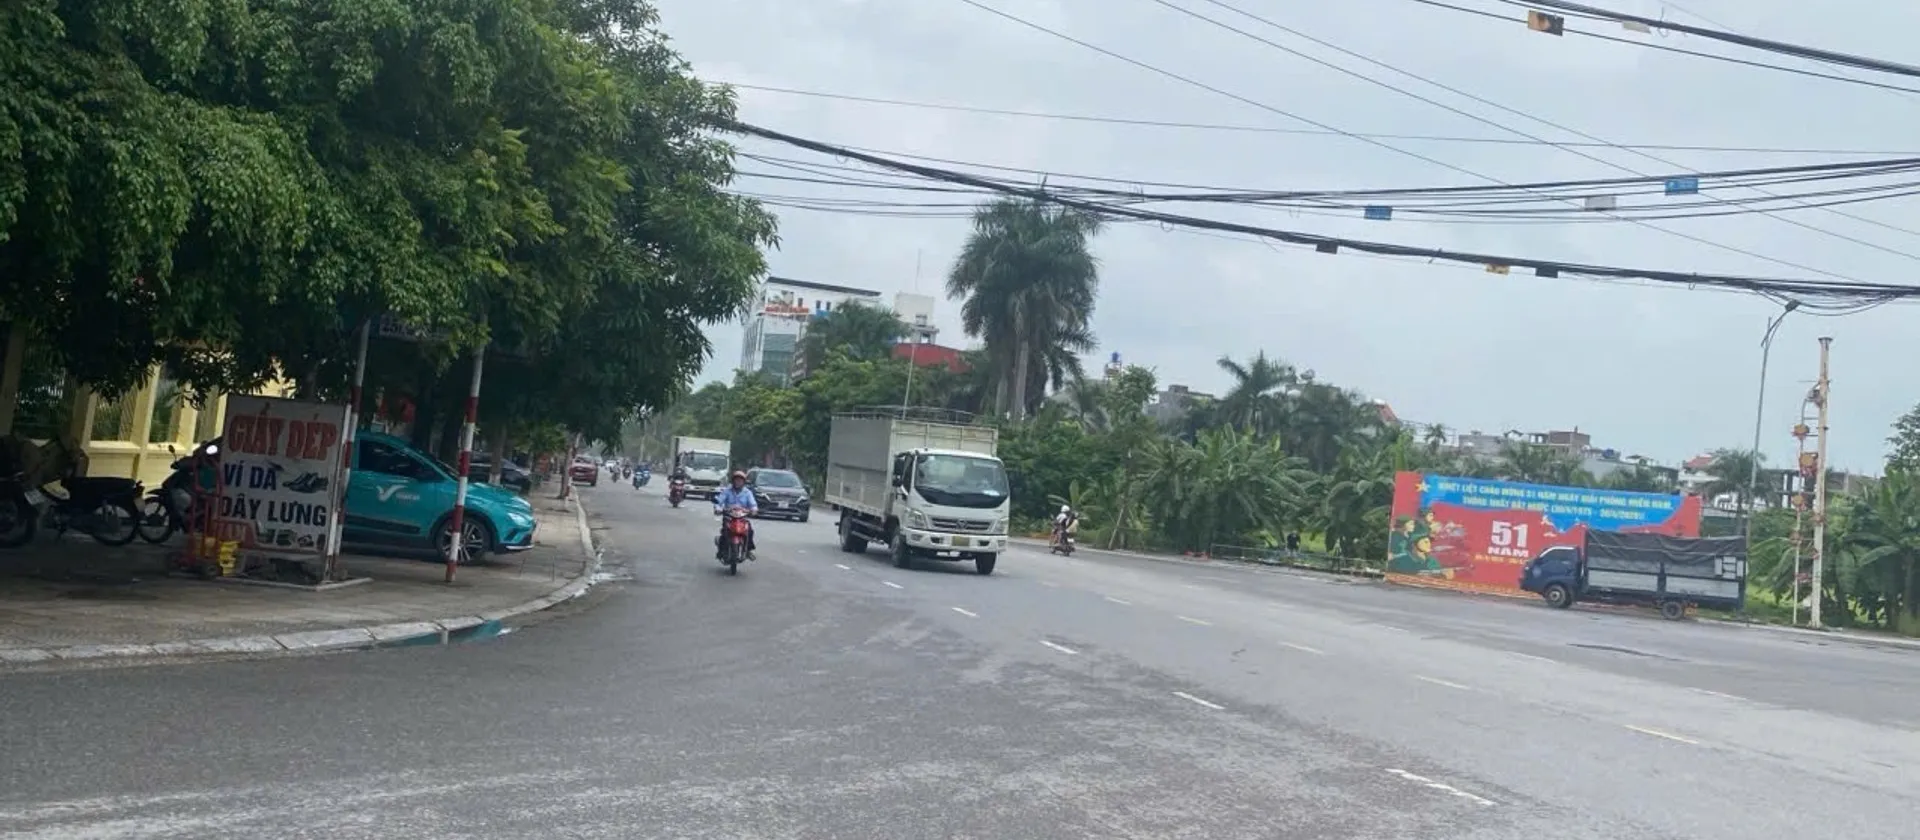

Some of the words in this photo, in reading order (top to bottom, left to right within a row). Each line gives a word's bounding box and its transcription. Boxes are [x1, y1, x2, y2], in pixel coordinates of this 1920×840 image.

[286, 413, 337, 460] DÉP
[224, 460, 243, 487] VÍ
[249, 466, 277, 490] DA
[221, 493, 261, 519] DÂY
[267, 501, 326, 526] LƯNG
[1491, 520, 1528, 548] 51
